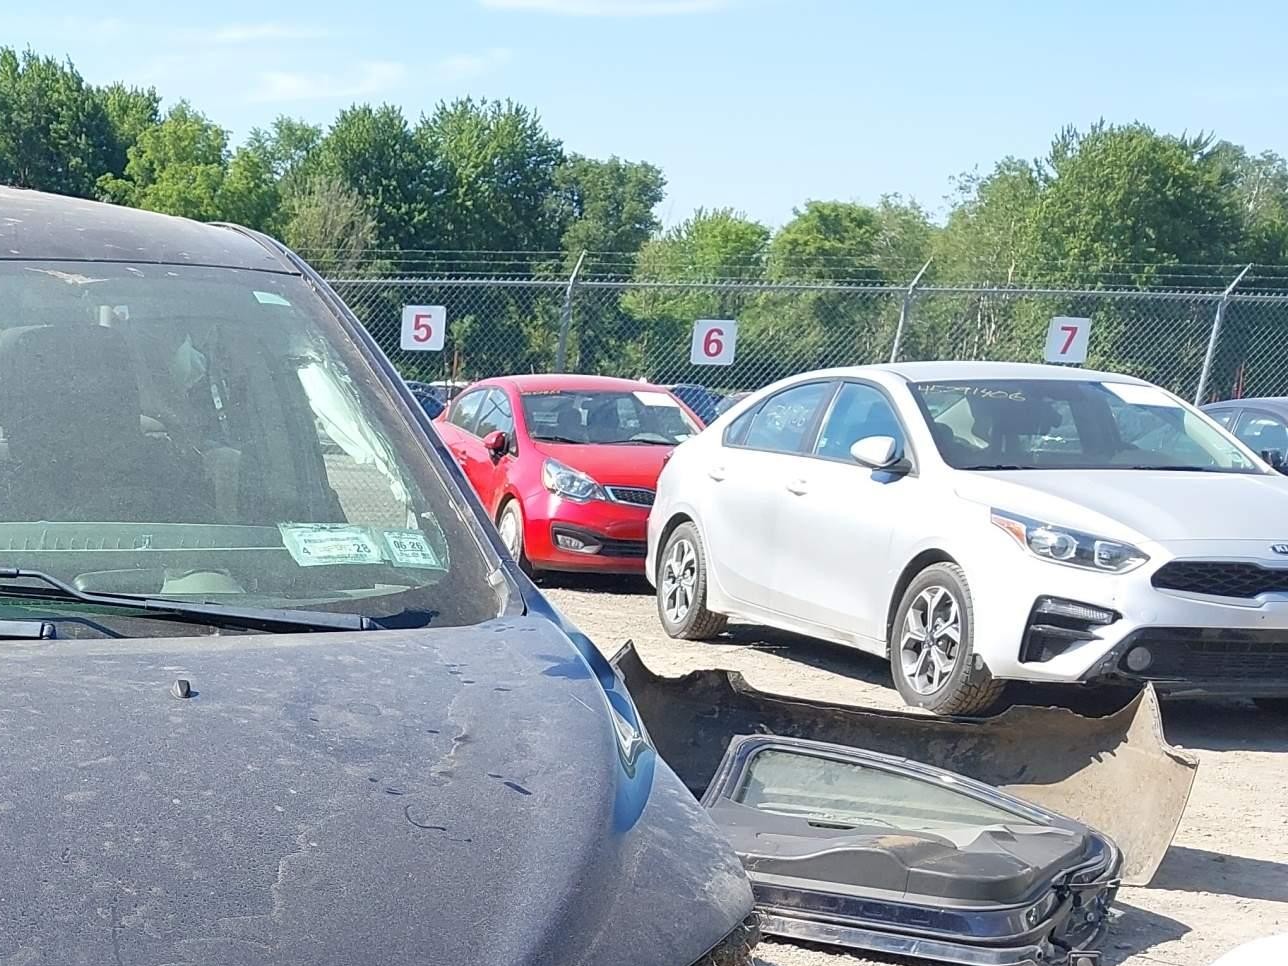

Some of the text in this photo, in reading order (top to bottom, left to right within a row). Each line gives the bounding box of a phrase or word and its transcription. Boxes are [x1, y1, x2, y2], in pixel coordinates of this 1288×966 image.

[413, 314, 432, 343] 5
[703, 327, 724, 357] 6
[1060, 326, 1078, 354] 7
